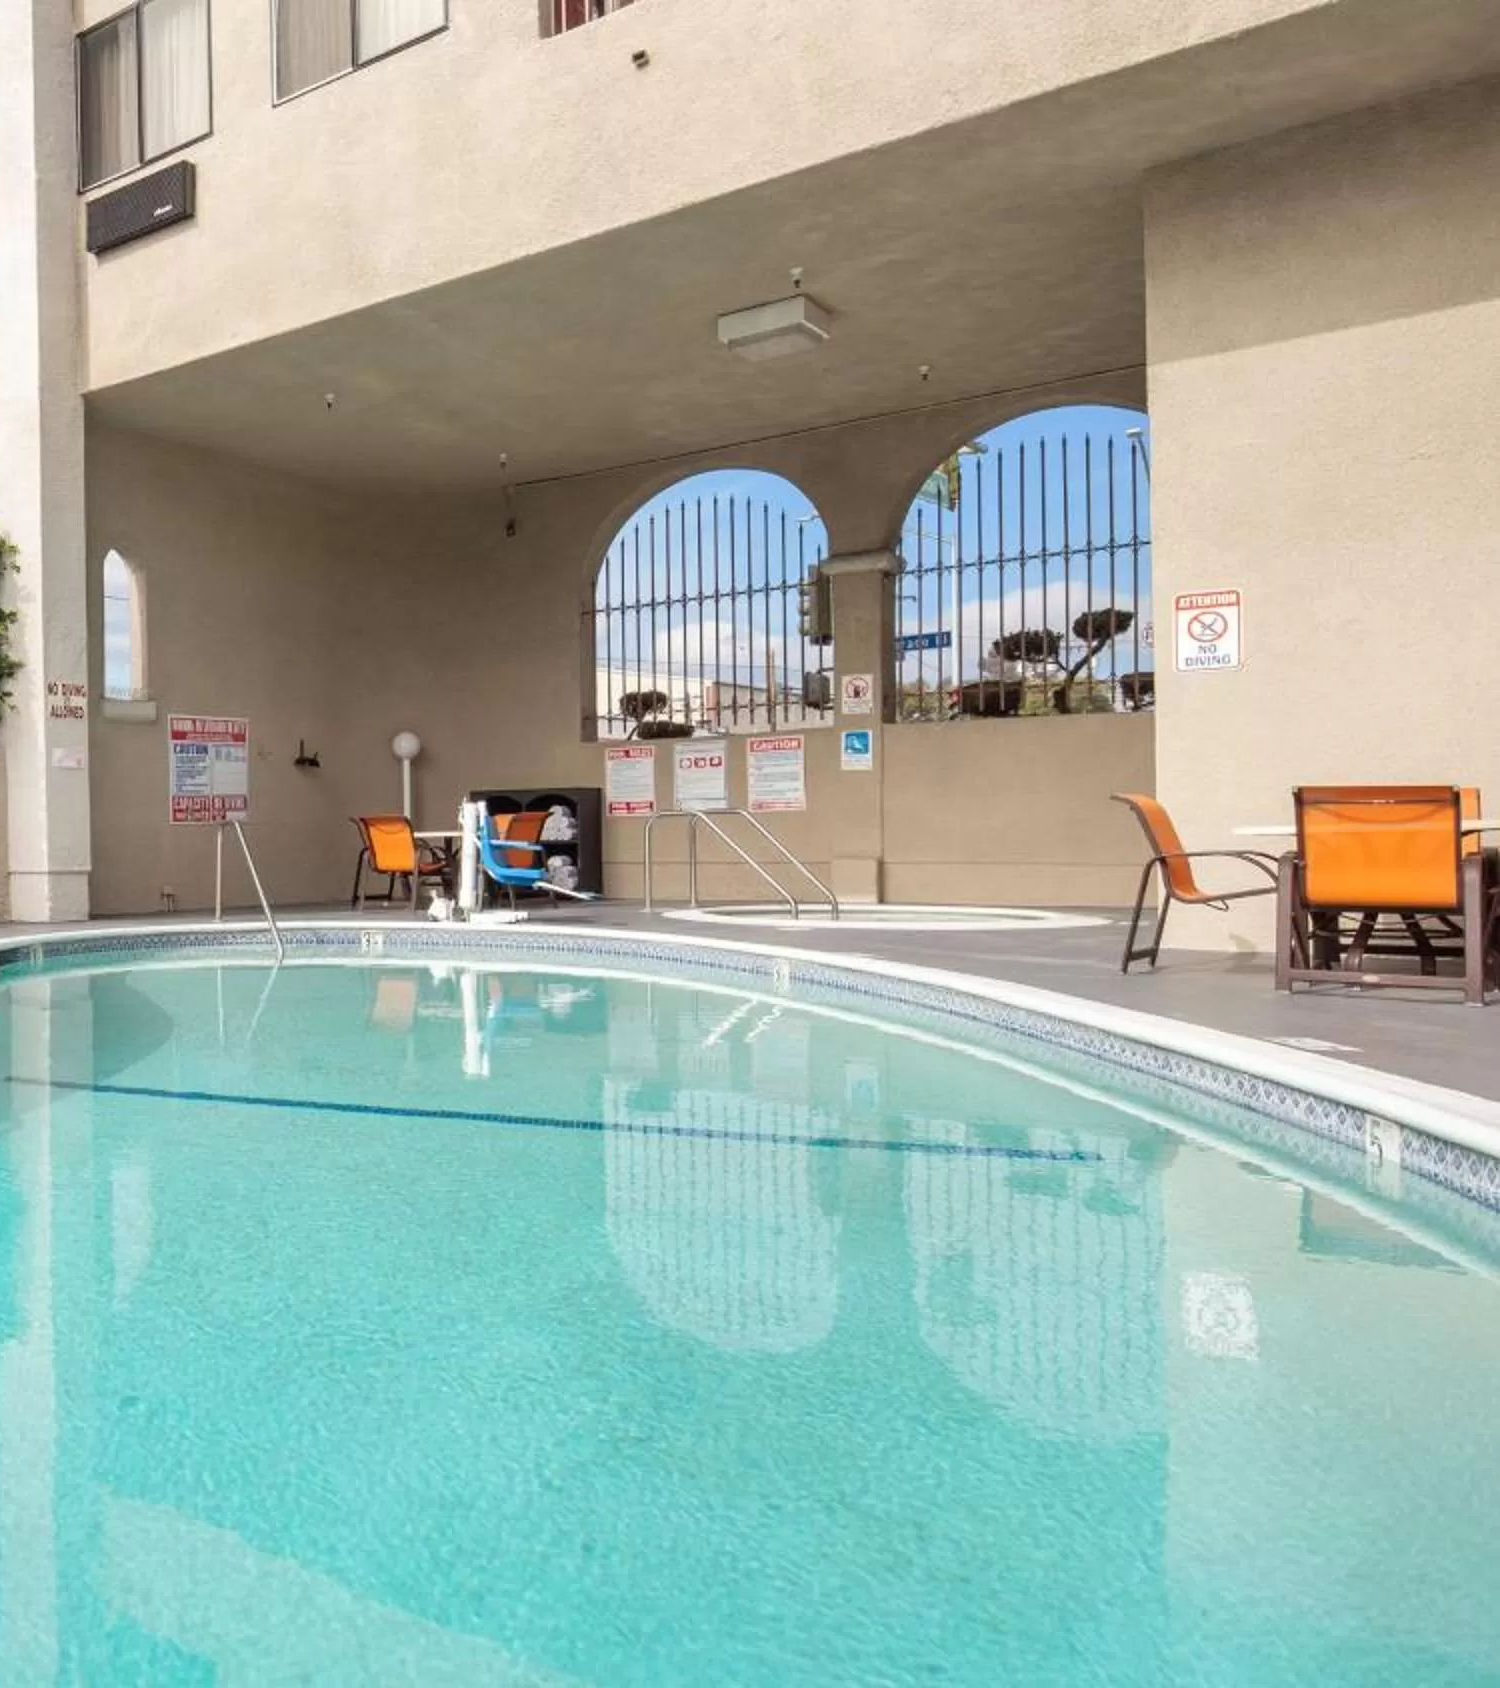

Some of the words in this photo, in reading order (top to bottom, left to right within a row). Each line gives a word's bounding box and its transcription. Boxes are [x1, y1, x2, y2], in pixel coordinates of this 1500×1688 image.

[1197, 643, 1217, 655] NO
[1185, 653, 1231, 667] DIVING
[47, 681, 59, 697] NO
